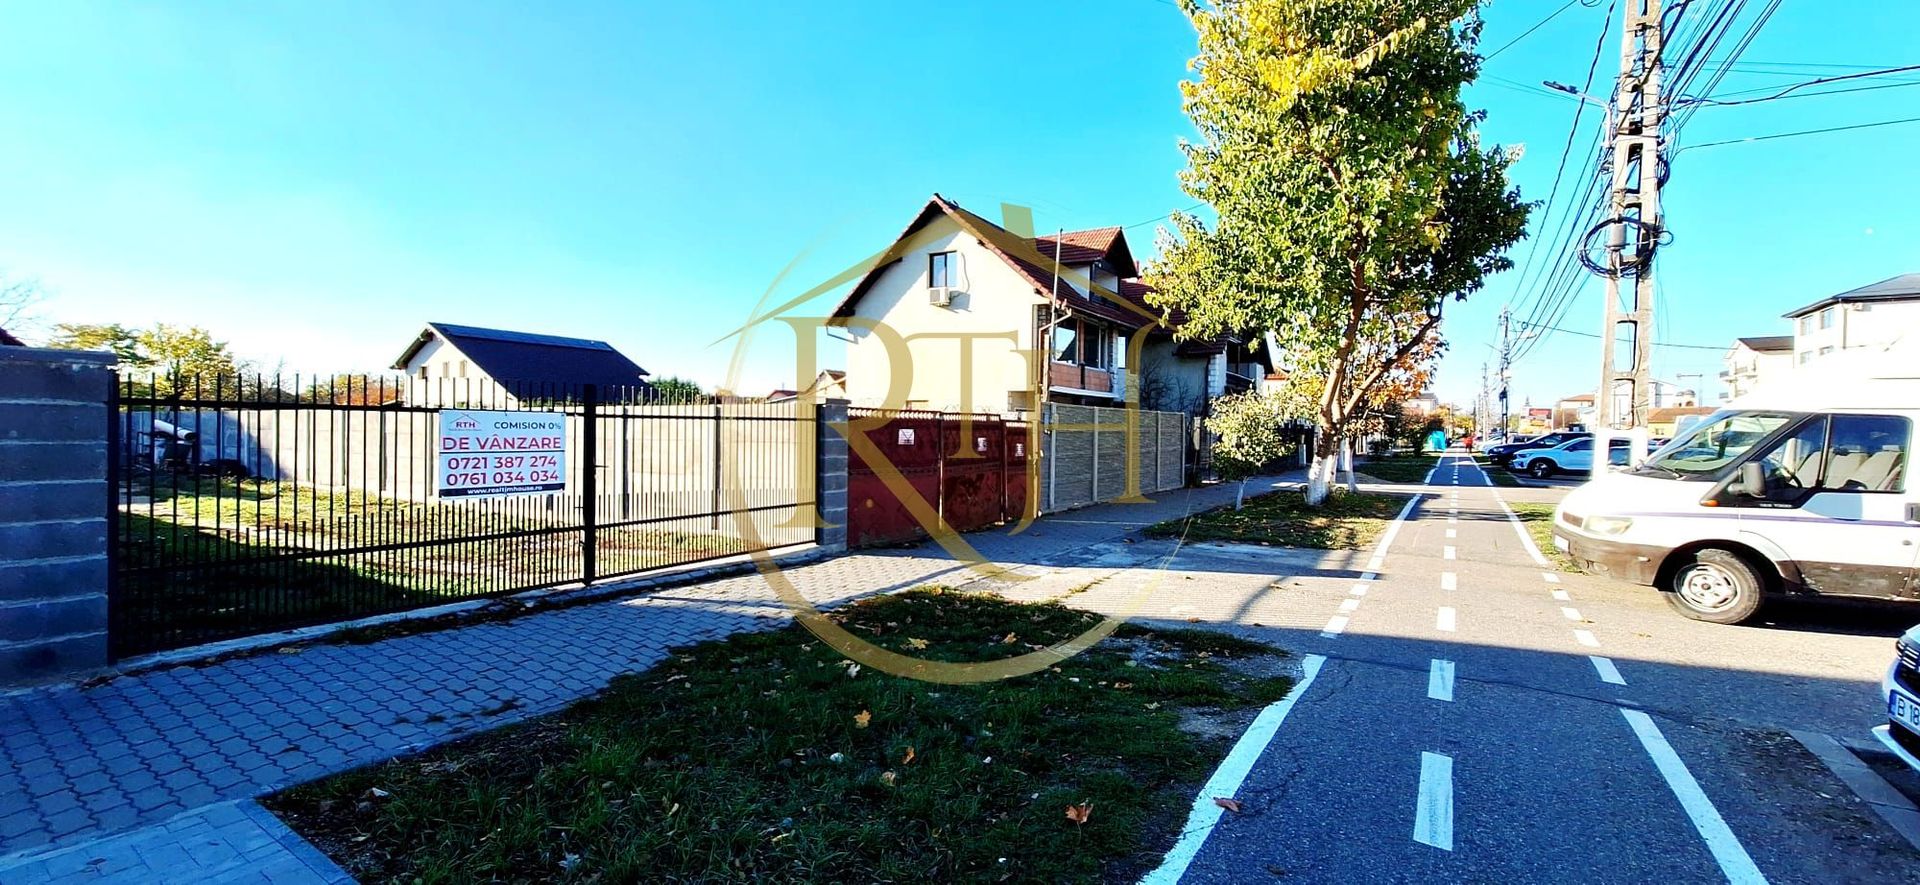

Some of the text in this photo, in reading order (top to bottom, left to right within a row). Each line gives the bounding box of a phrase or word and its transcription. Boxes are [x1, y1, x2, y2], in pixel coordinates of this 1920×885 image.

[494, 421, 561, 430] COMISION 0%
[442, 434, 561, 450] DE VÂNZARE
[447, 456, 557, 470] 0721 387 274
[446, 470, 559, 486] 0761 034 034
[1898, 698, 1905, 717] B
